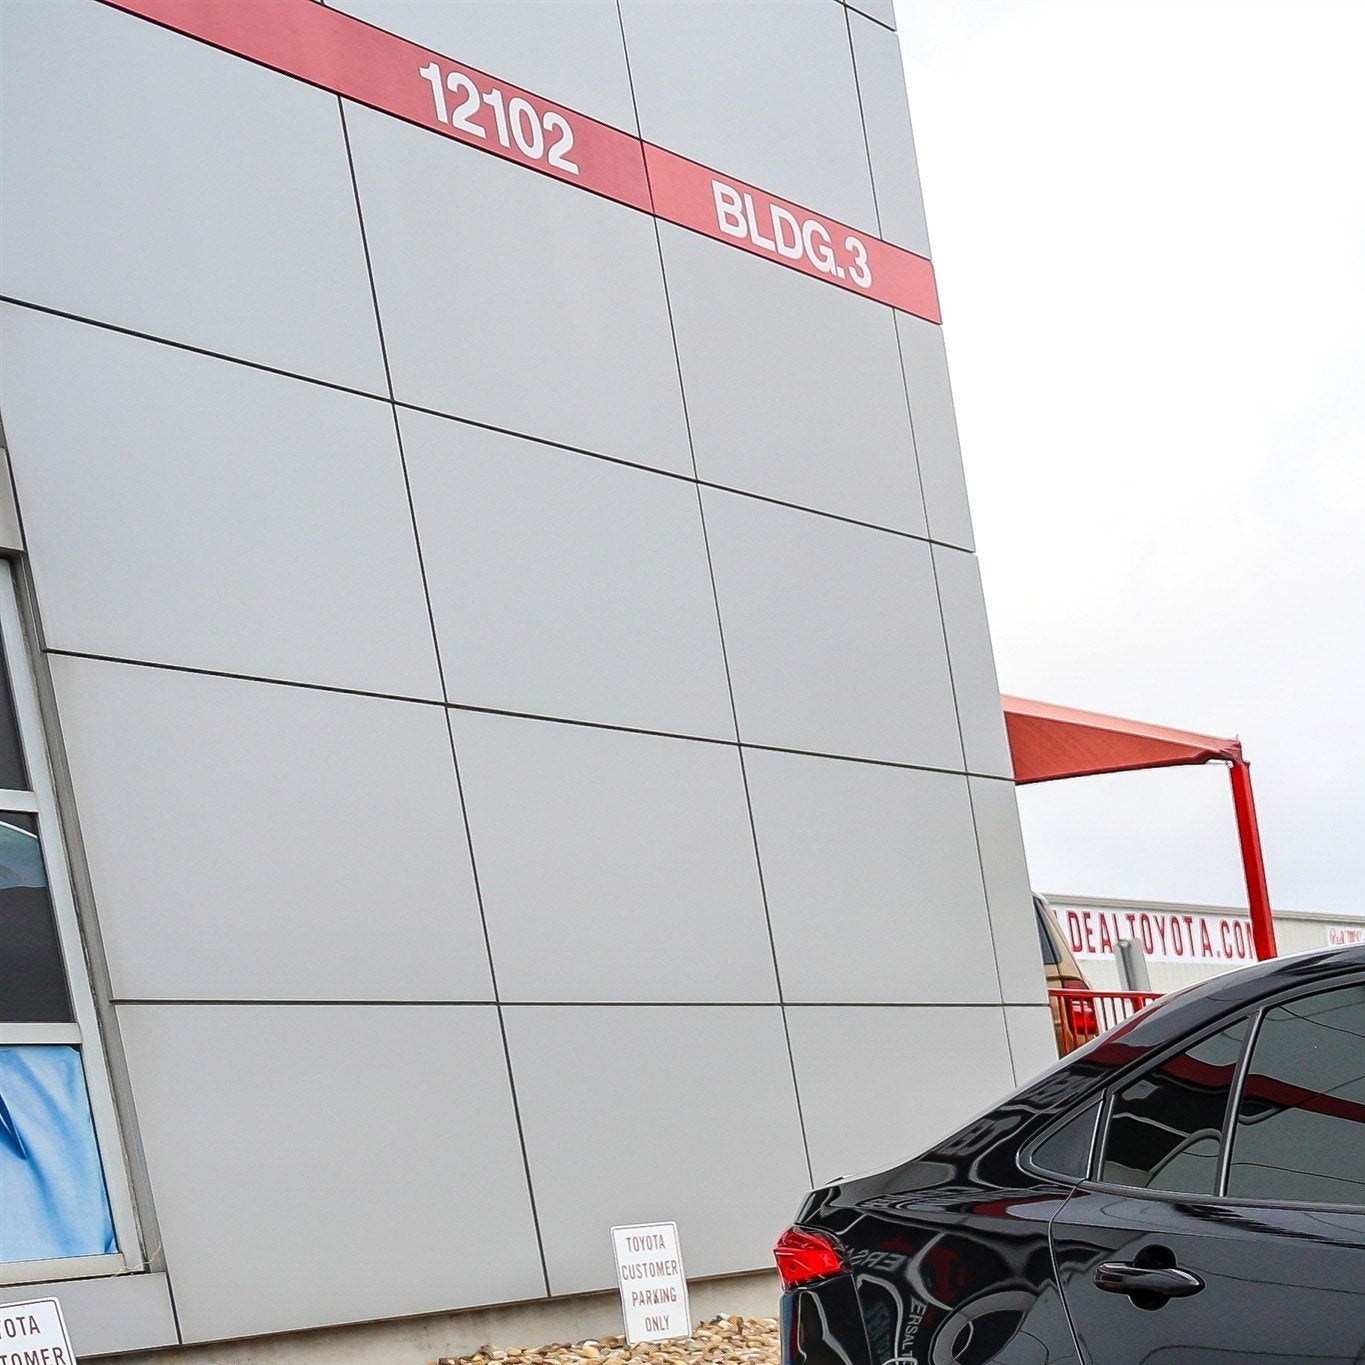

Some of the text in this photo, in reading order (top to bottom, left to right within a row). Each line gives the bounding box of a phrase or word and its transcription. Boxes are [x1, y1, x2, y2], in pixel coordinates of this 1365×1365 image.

[419, 61, 580, 176] 12102
[1053, 908, 1254, 960] DEALTOYOTA.CO
[625, 1234, 666, 1253] TOYOTA
[621, 1260, 679, 1281] CUSTOMER
[631, 1287, 677, 1307] PARKING
[0, 1315, 41, 1340] OTA
[645, 1314, 670, 1332] ONLY
